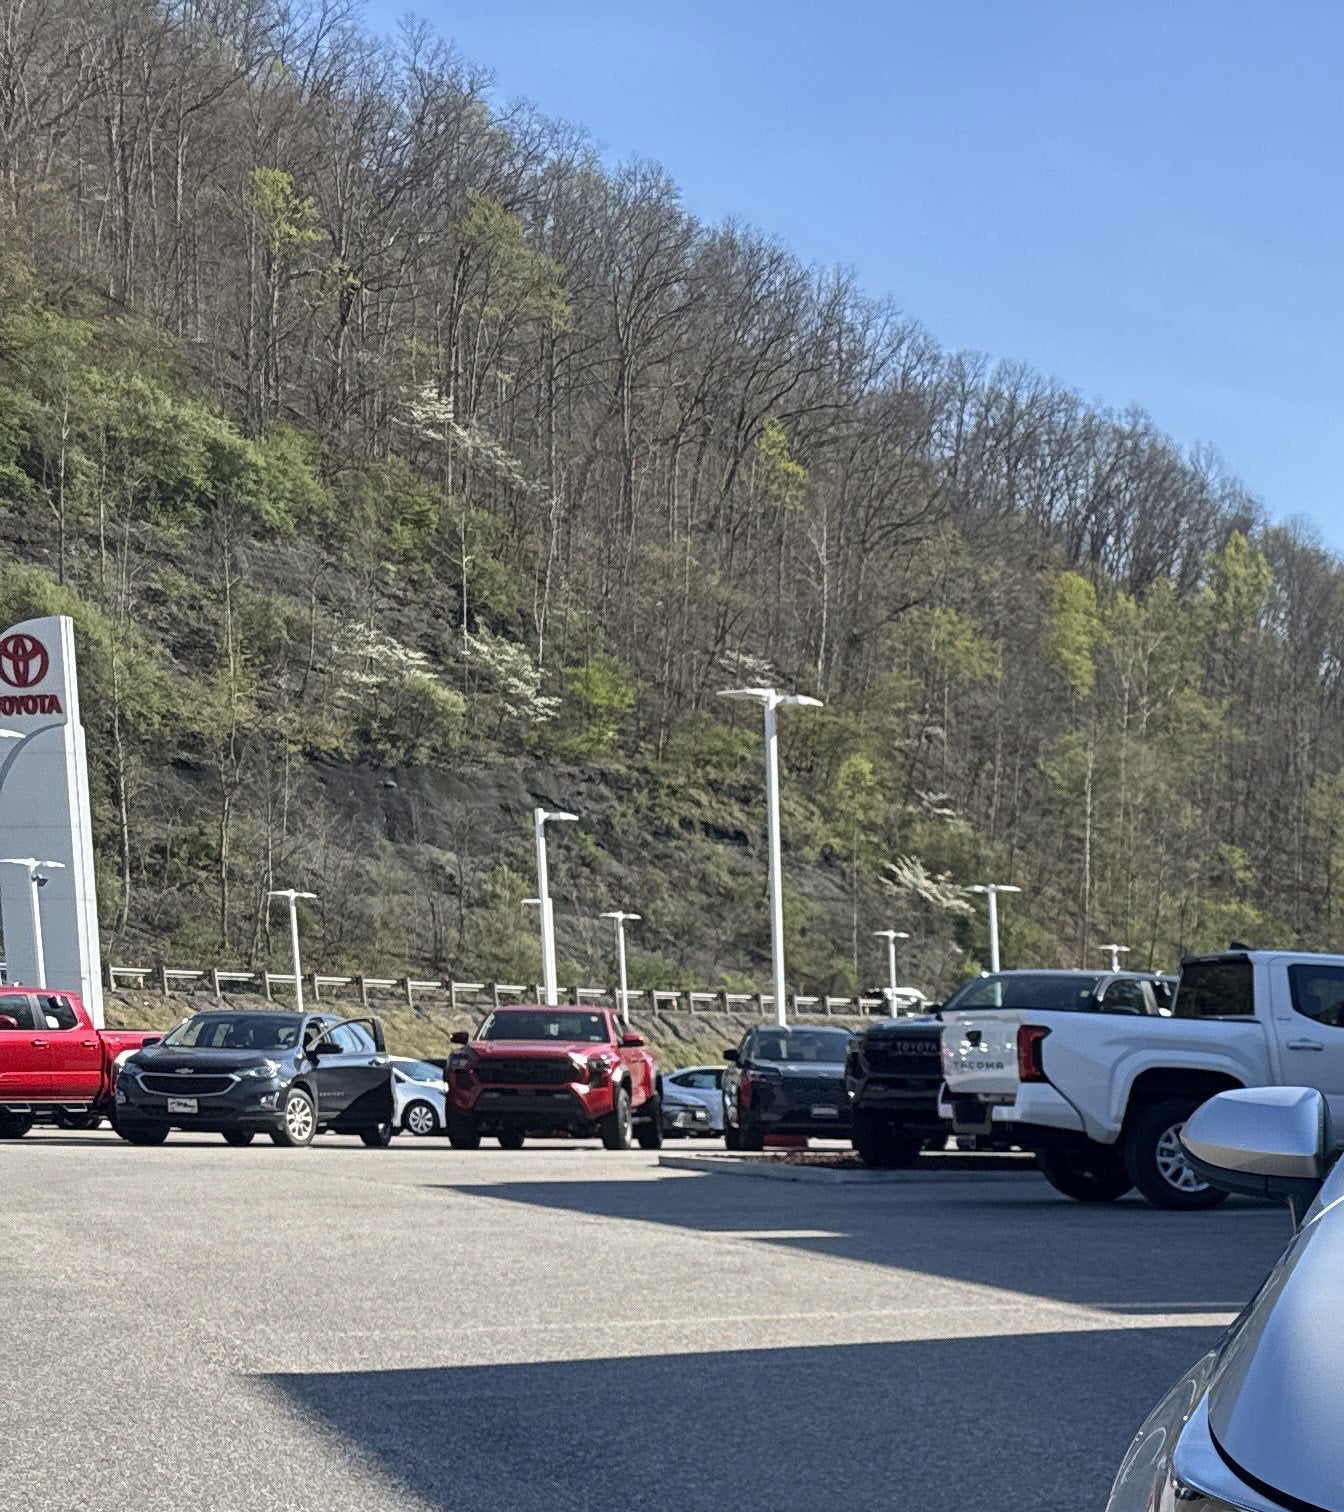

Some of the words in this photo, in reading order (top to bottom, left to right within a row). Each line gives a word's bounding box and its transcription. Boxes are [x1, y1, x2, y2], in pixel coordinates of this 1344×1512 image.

[0, 695, 63, 716] OYOTA
[896, 1041, 938, 1053] TOYOTA
[953, 1061, 1005, 1070] TACOMA
